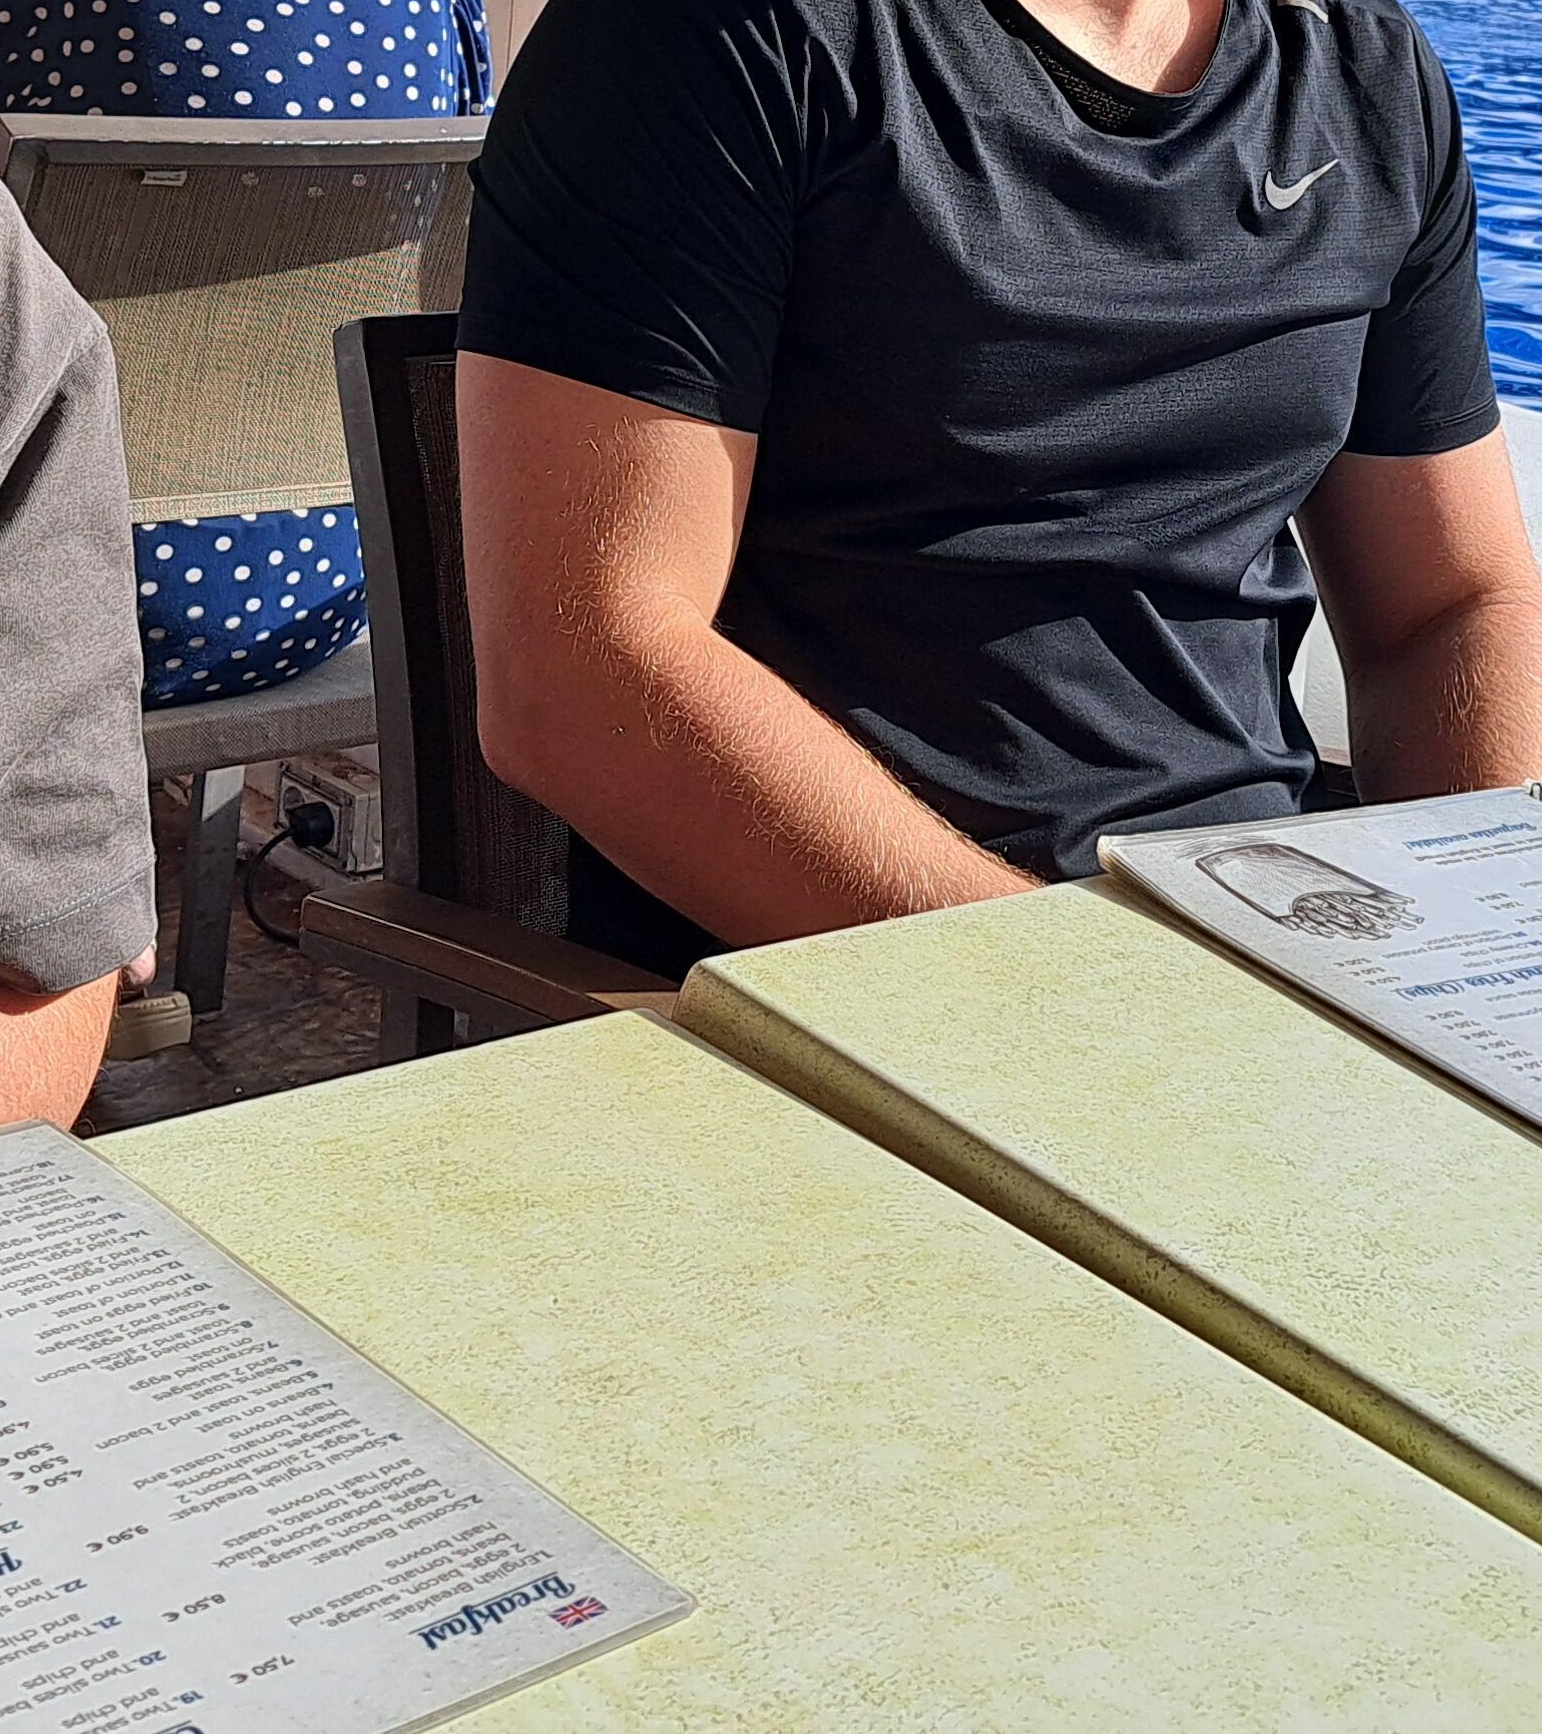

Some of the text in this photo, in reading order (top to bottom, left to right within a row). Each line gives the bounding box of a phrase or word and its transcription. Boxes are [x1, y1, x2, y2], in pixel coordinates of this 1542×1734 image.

[1388, 978, 1465, 1002] (Chips)
[1462, 972, 1516, 987] Fries
[384, 1520, 498, 1569] hash browns
[3, 1577, 43, 1598] and
[53, 1577, 88, 1593] 22.
[286, 1531, 512, 1627] beans, tomato, toasts and
[319, 1541, 527, 1627] 2 eggs, bacon, sausage,
[13, 1590, 59, 1608] Two
[416, 1574, 576, 1651] Breakfast
[228, 1654, 295, 1684] 7,50 €
